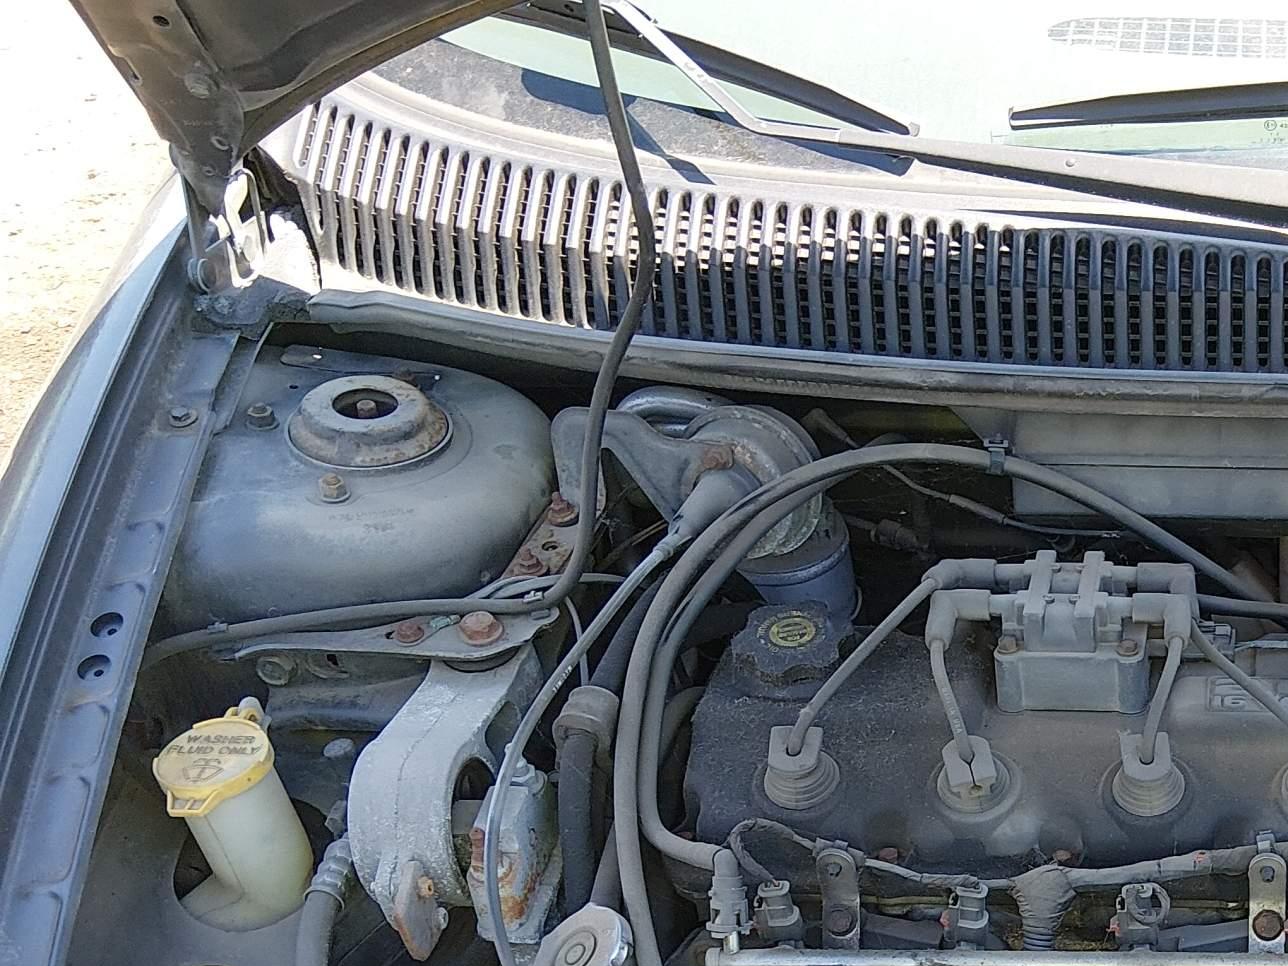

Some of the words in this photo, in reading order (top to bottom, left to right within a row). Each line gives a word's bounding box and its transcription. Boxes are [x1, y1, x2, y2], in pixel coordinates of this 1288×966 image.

[187, 735, 256, 744] WASHER
[167, 745, 214, 754] FLUID
[219, 745, 261, 755] ONLY
